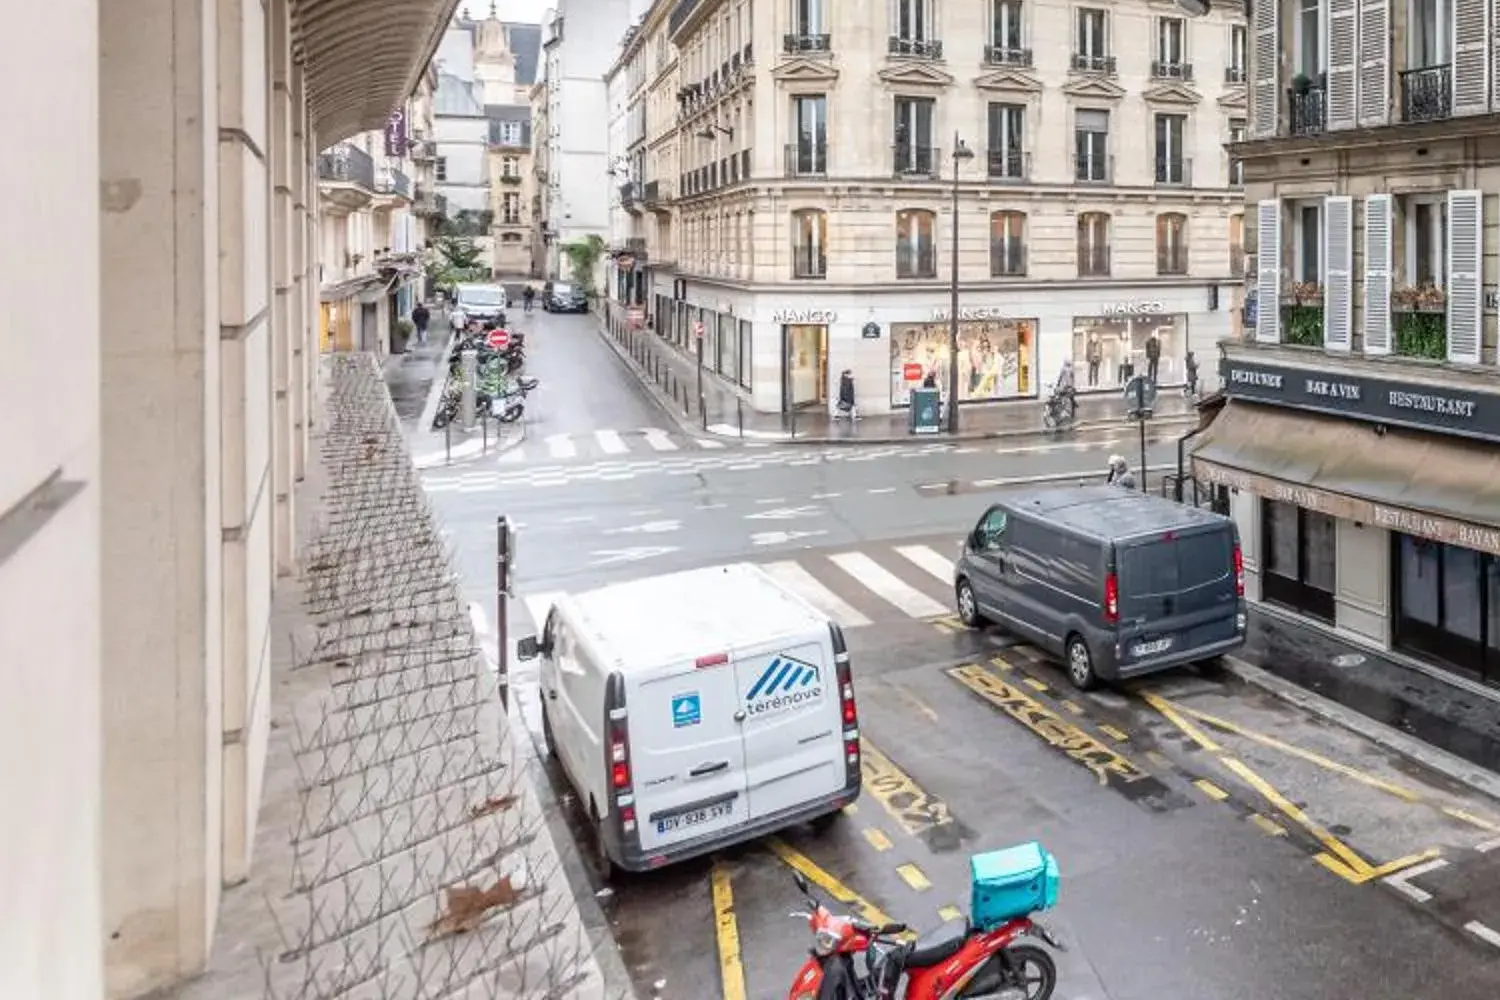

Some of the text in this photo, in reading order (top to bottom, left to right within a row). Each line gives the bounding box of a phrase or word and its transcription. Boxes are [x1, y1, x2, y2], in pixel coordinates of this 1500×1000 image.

[389, 110, 403, 155] OTEL
[772, 308, 838, 324] MANGO
[1103, 300, 1164, 315] MANGO
[1389, 391, 1475, 417] RESTAURANT
[1459, 526, 1500, 549] BAYAN
